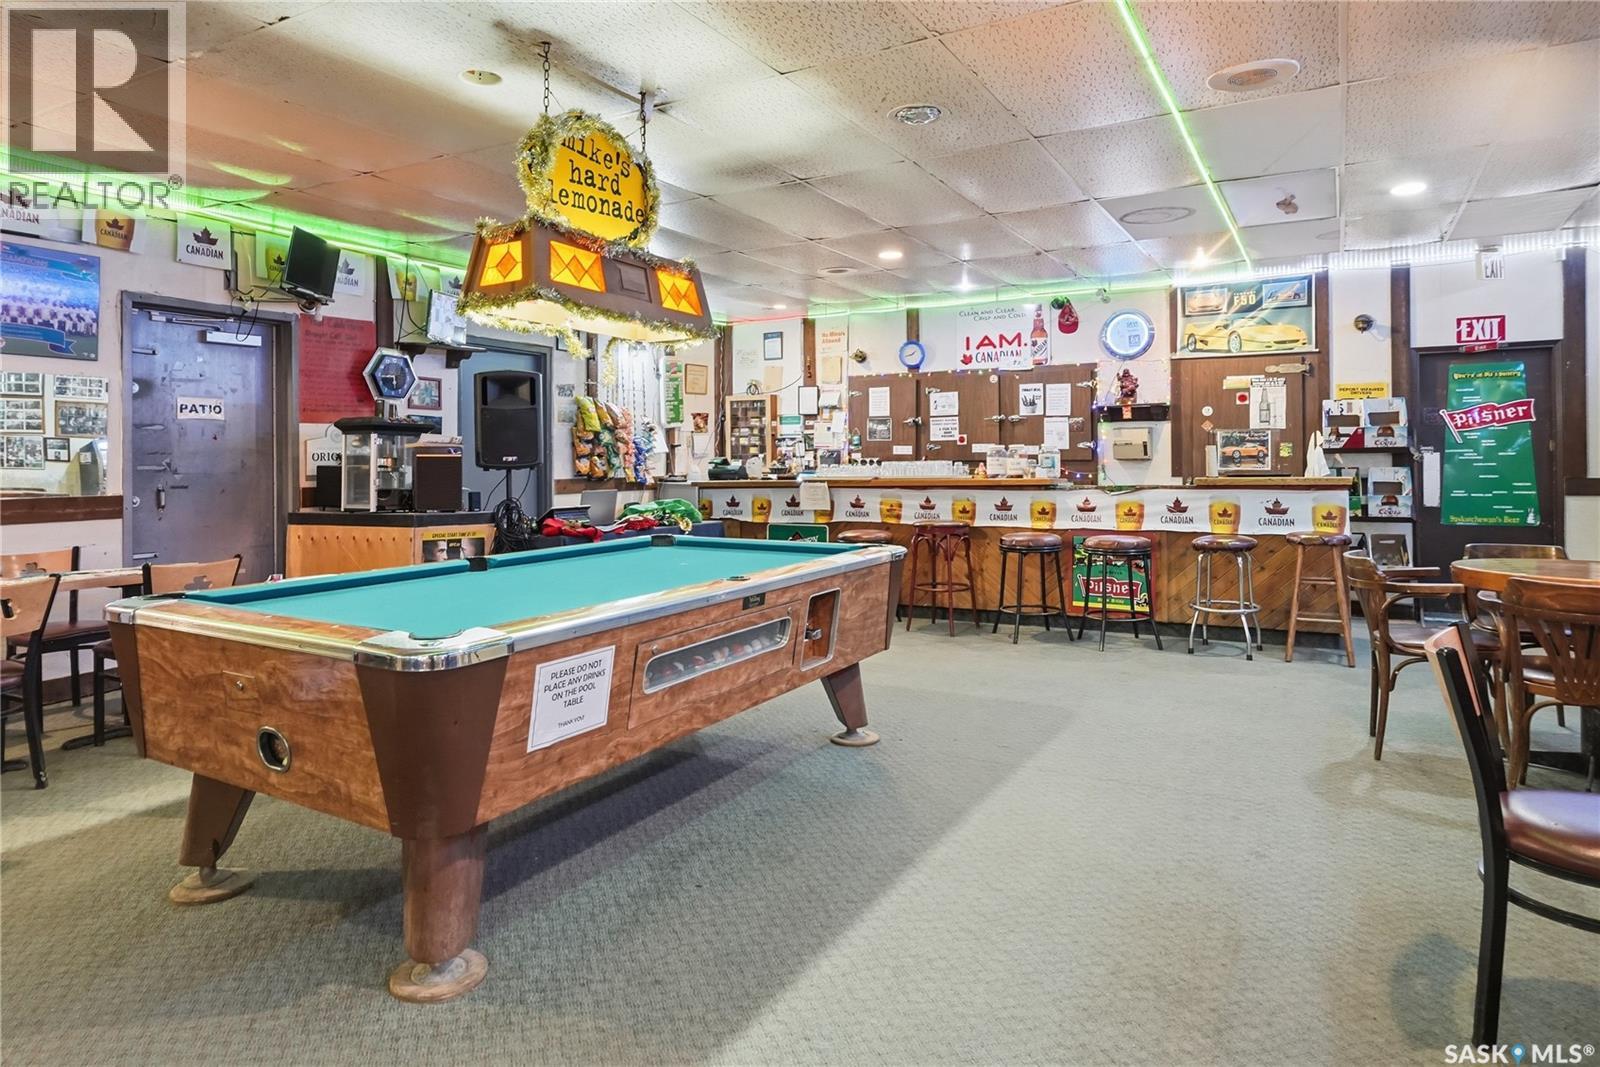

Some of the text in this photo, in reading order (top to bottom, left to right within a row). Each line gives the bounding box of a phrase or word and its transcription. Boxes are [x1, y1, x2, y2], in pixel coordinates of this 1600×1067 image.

[561, 134, 631, 178] mike's
[569, 159, 622, 195] hard
[549, 179, 645, 224] lemonade
[185, 244, 225, 260] CANADIAN
[1484, 258, 1504, 278] EXIT
[1460, 318, 1503, 340] EXIT
[966, 332, 1028, 351] I AM.
[180, 403, 222, 414] PATIO
[1453, 405, 1528, 427] Pilsner
[845, 510, 870, 518] CANADIAN
[914, 511, 941, 520] CANADIAN
[989, 513, 1018, 521] CANADIAN
[1071, 514, 1102, 523] CANADIAN
[1160, 515, 1194, 524] CANADIAN
[1258, 517, 1295, 527] CANADIAN
[551, 659, 603, 680] PLEASE DO NOT
[544, 668, 607, 693] PLACE ANY DRINKS
[551, 682, 596, 701] ON THE POOL
[563, 695, 584, 708] TABLE
[558, 718, 573, 728] THANK
